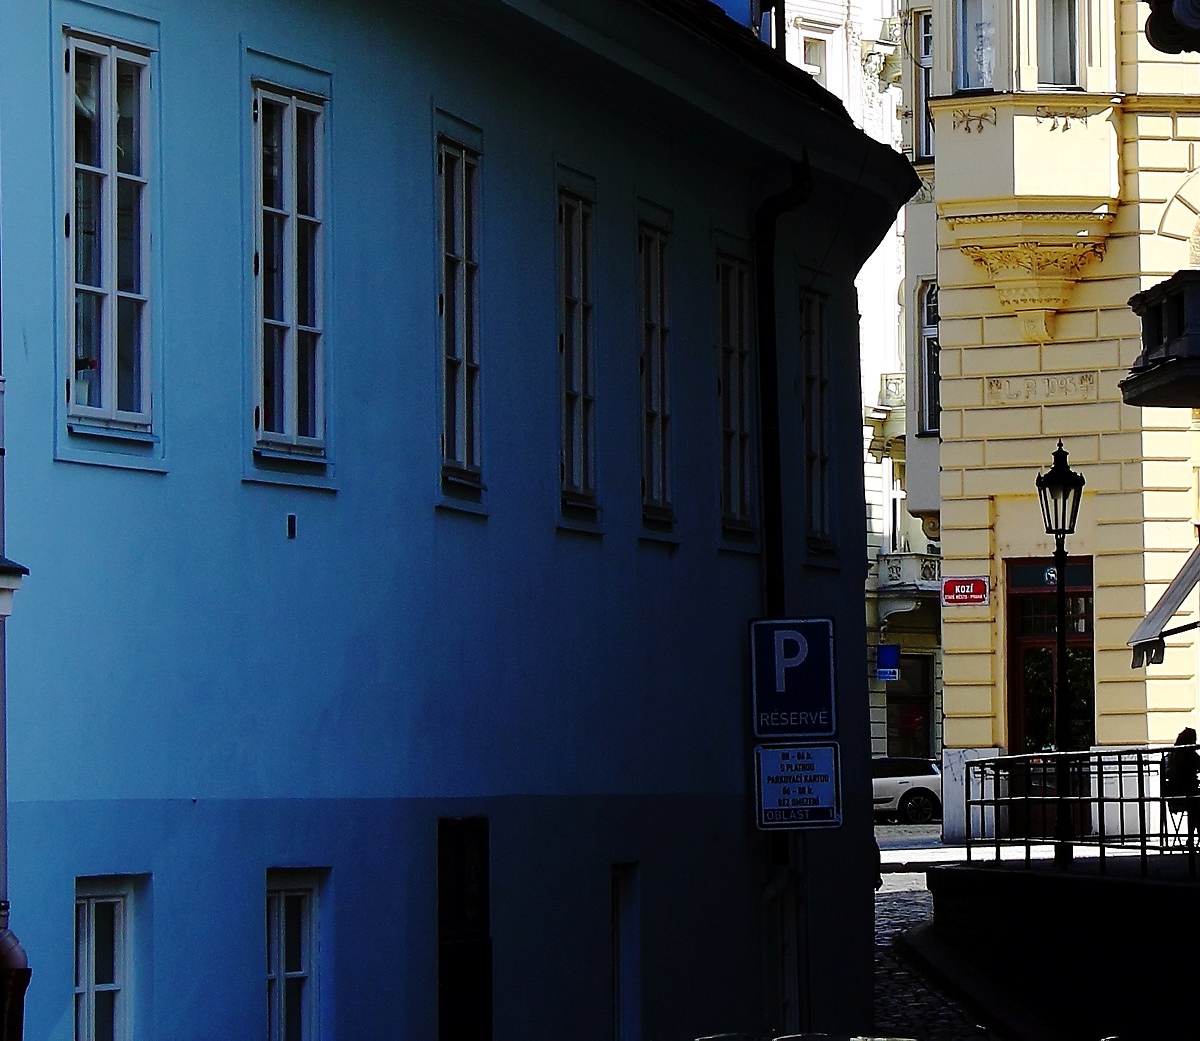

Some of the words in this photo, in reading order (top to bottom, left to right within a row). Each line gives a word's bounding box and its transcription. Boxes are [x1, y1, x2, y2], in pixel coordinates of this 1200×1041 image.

[955, 582, 974, 593] KOZÍ
[774, 629, 809, 692] P
[760, 707, 828, 727] RÉSERVÉ
[786, 763, 815, 772] PLATNOU
[767, 773, 803, 783] PARKOVACÍ
[766, 809, 811, 820] OBLAST
